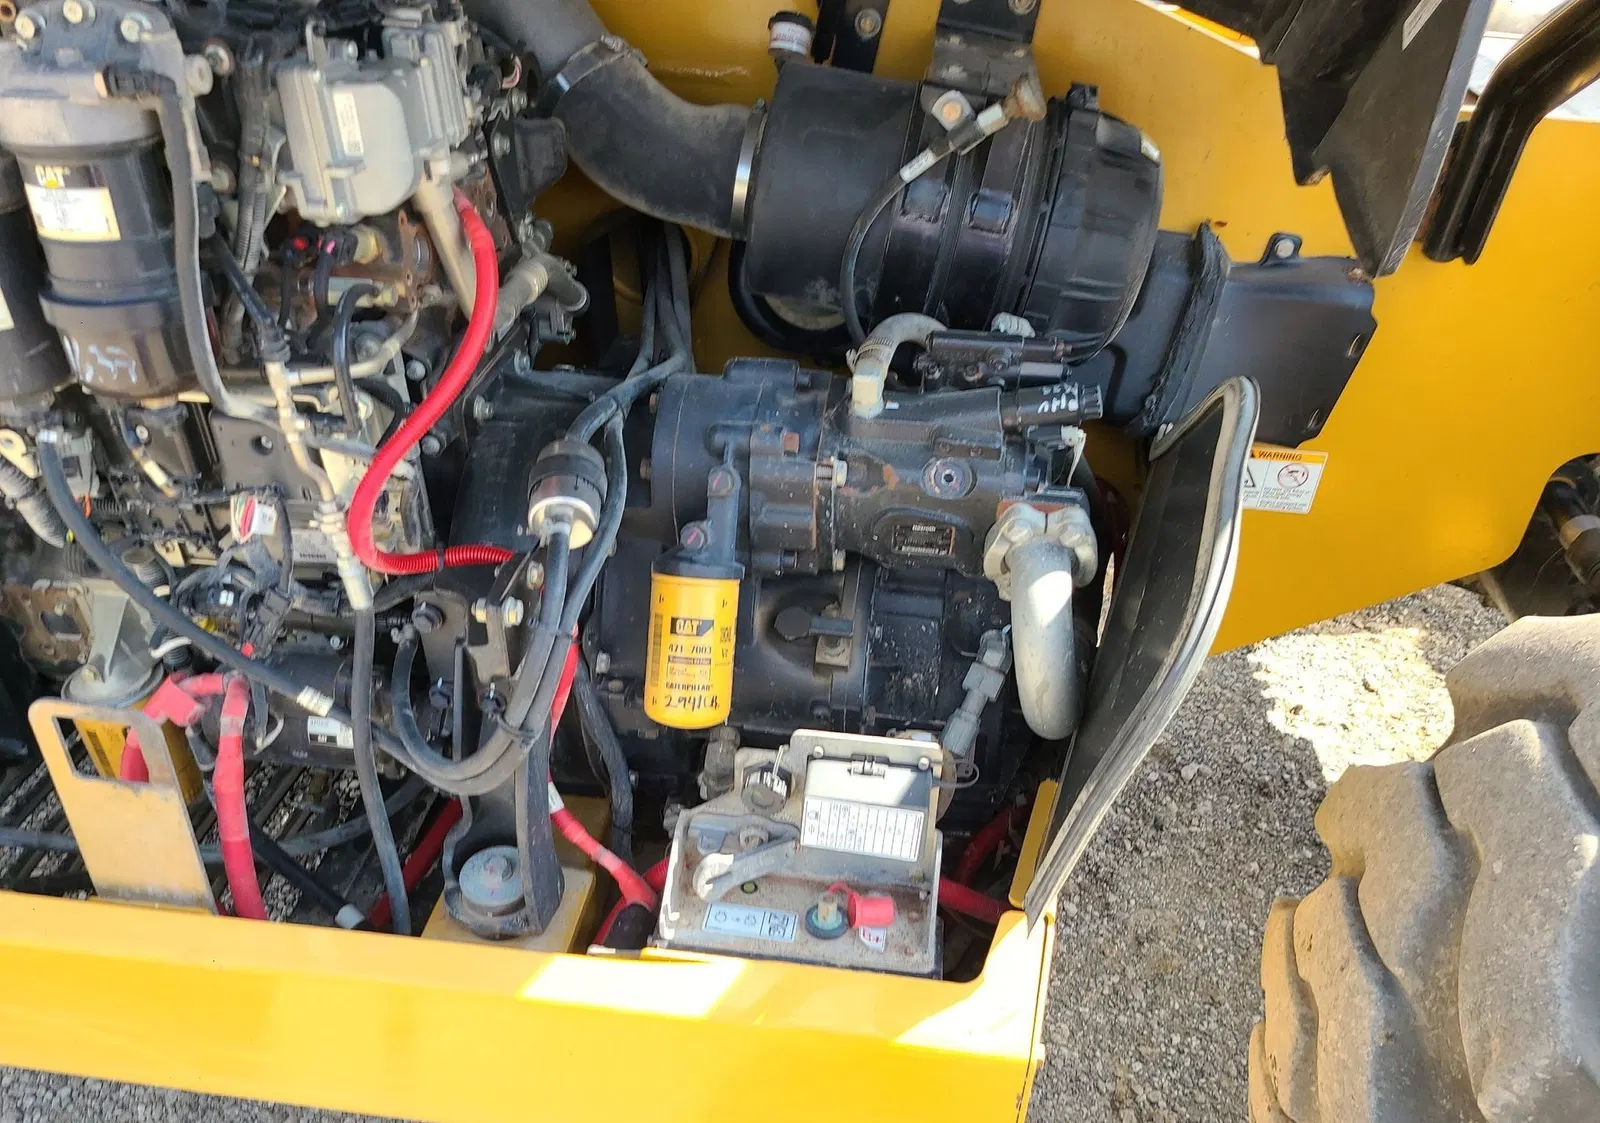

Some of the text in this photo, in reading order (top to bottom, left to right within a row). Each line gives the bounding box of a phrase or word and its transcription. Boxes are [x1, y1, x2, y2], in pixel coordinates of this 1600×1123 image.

[35, 164, 66, 188] CAT
[1258, 450, 1302, 461] WARNING
[675, 618, 699, 635] CAT
[665, 682, 711, 692] CATERPILLAR
